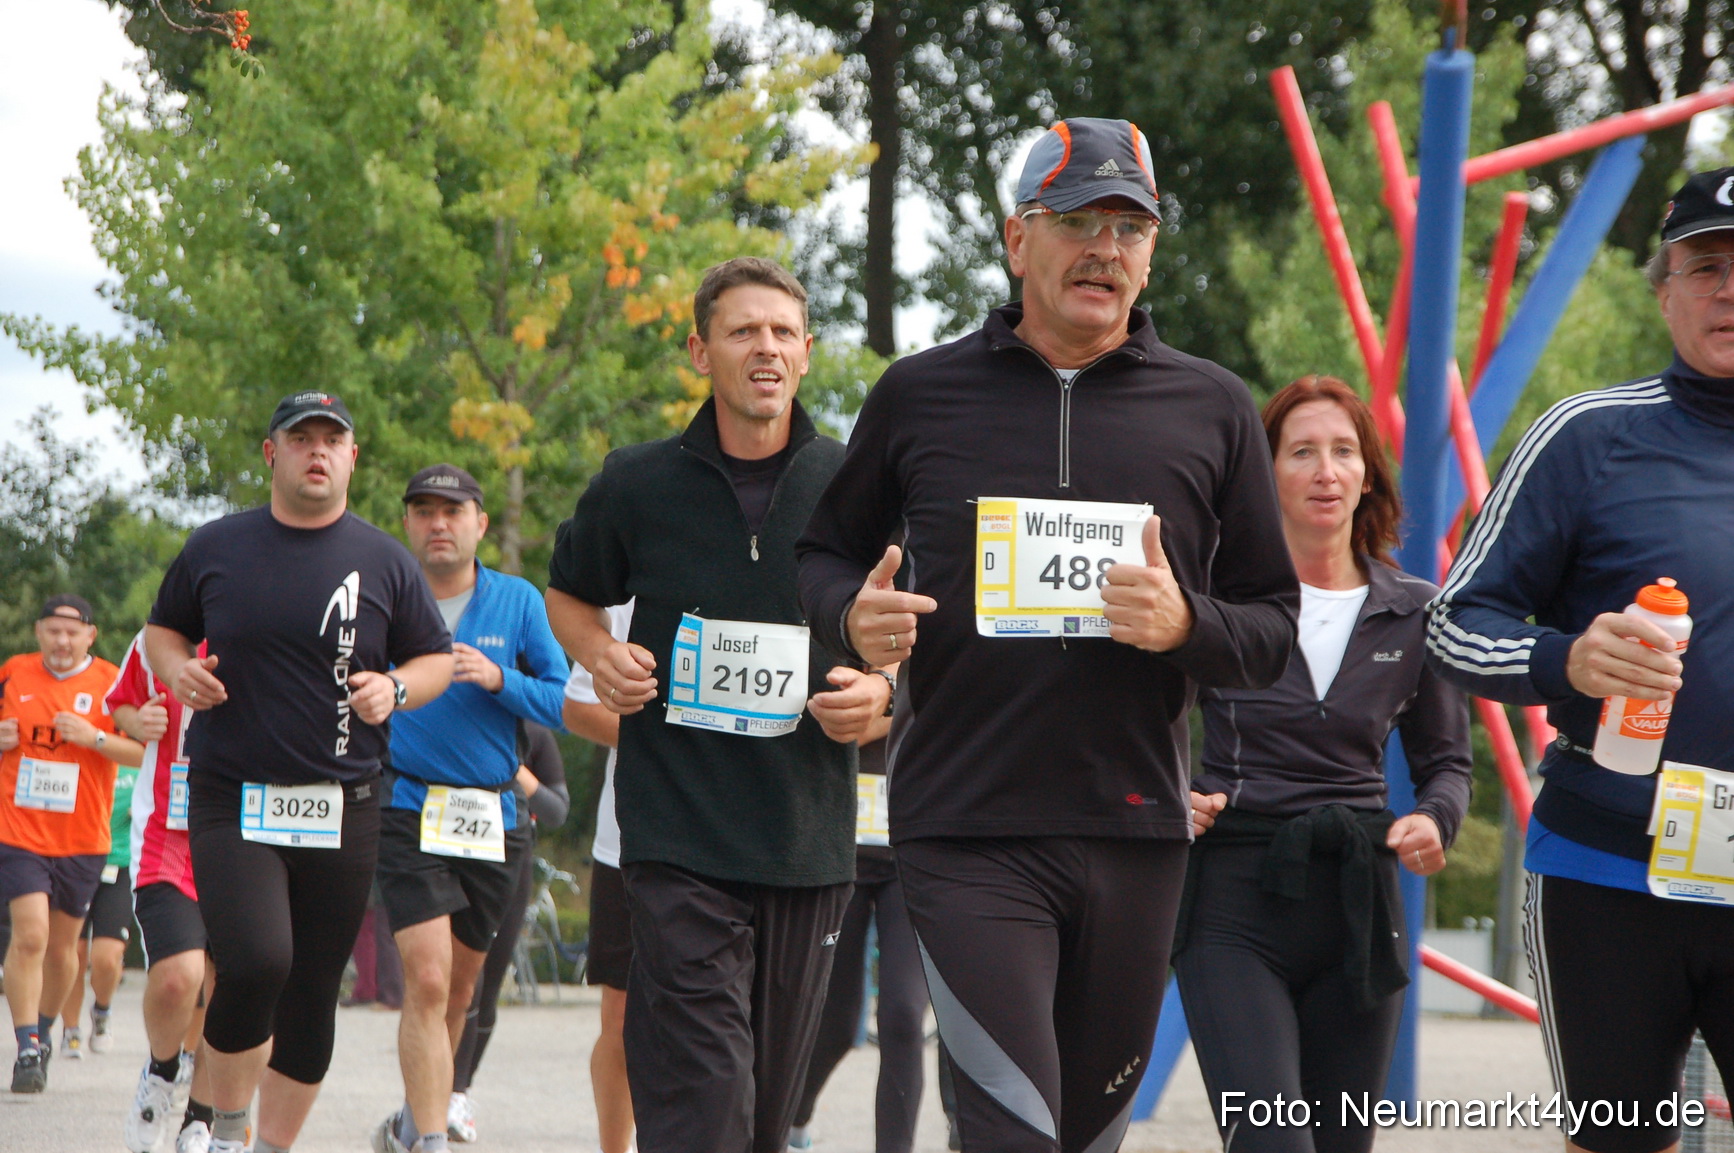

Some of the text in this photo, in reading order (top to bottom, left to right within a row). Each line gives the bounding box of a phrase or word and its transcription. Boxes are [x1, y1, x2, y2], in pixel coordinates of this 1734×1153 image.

[1094, 169, 1124, 178] adidas
[1025, 511, 1124, 547] Wolfgang
[984, 552, 995, 571] D
[995, 620, 1039, 630] BOCK
[1083, 616, 1113, 628] PFLEI
[712, 632, 759, 655] Josef
[682, 657, 690, 672] D
[712, 664, 794, 698] 2197
[271, 797, 330, 819] 3029
[452, 816, 492, 838] 247
[1665, 820, 1677, 838] D
[1668, 882, 1715, 896] BOCK
